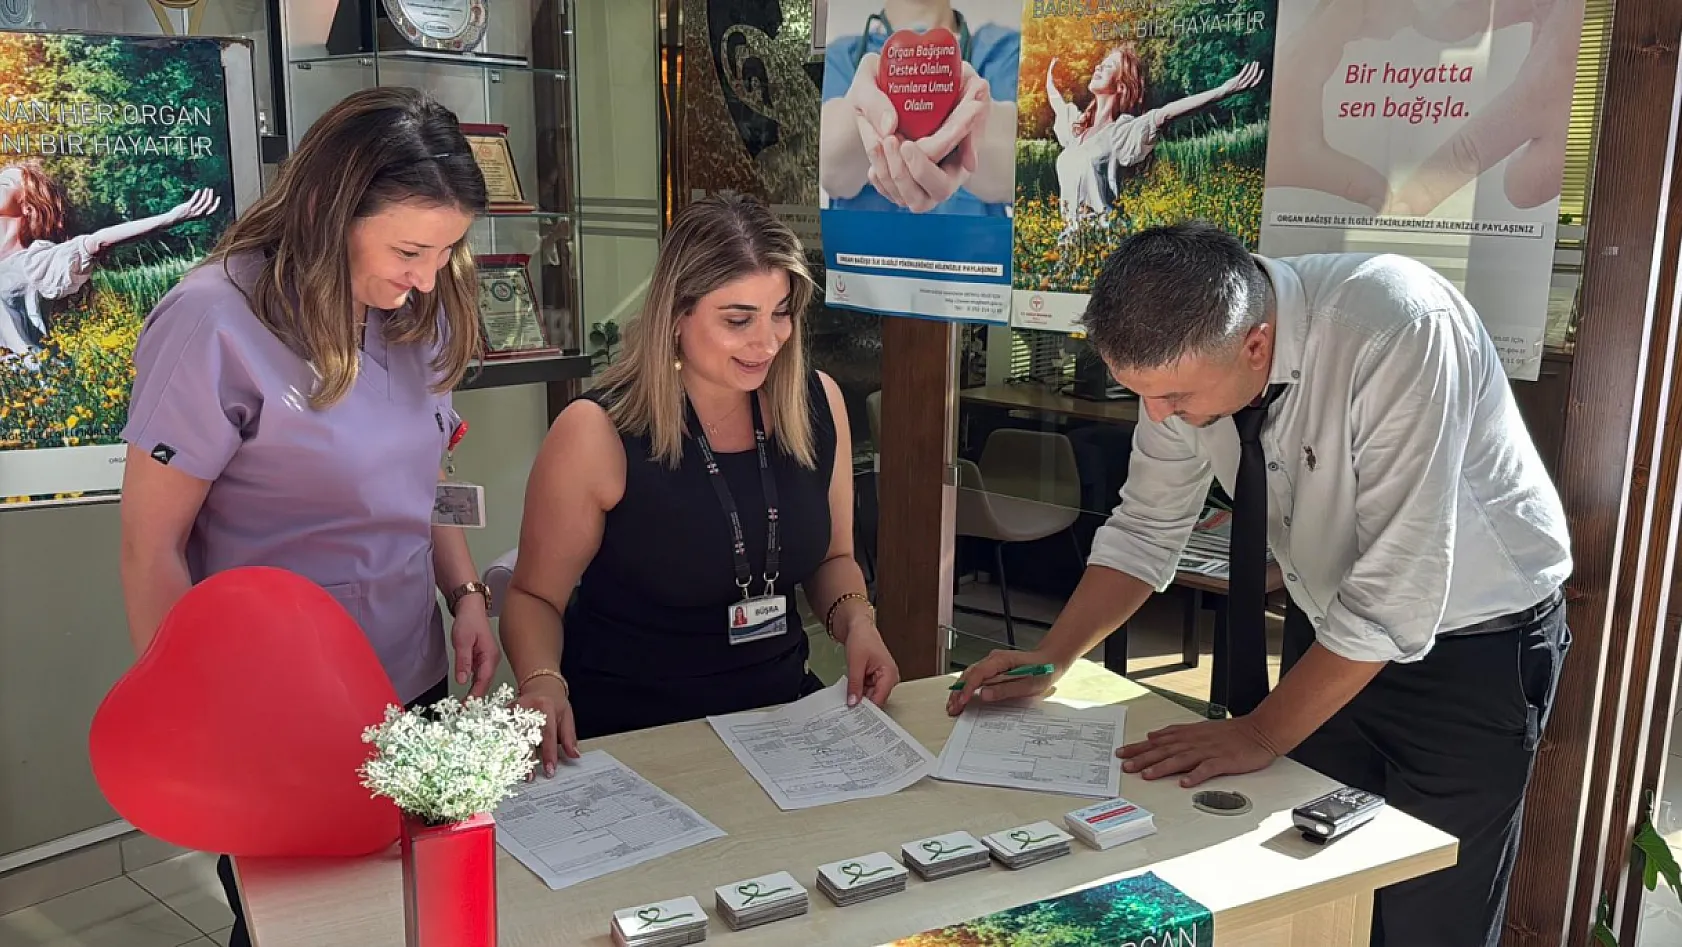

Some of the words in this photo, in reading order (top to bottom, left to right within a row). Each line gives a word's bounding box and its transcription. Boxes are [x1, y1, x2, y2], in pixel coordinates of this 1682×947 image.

[1173, 11, 1265, 33] HAYATTIR
[888, 46, 914, 60] Organ
[916, 44, 955, 59] Bağışına
[889, 63, 918, 76] Destek
[920, 62, 952, 77] Olalım,
[1345, 63, 1377, 84] Bir
[1382, 62, 1473, 89] hayatta
[888, 81, 928, 93] Yarınlara
[929, 80, 954, 92] Umut
[60, 101, 113, 124] HER
[123, 104, 211, 125] ORGAN
[904, 98, 933, 111] Olalım
[1338, 101, 1376, 118] sen
[1382, 96, 1469, 124] bağışla.
[95, 134, 213, 157] HAYATTIR
[1277, 214, 1303, 223] ORGAN
